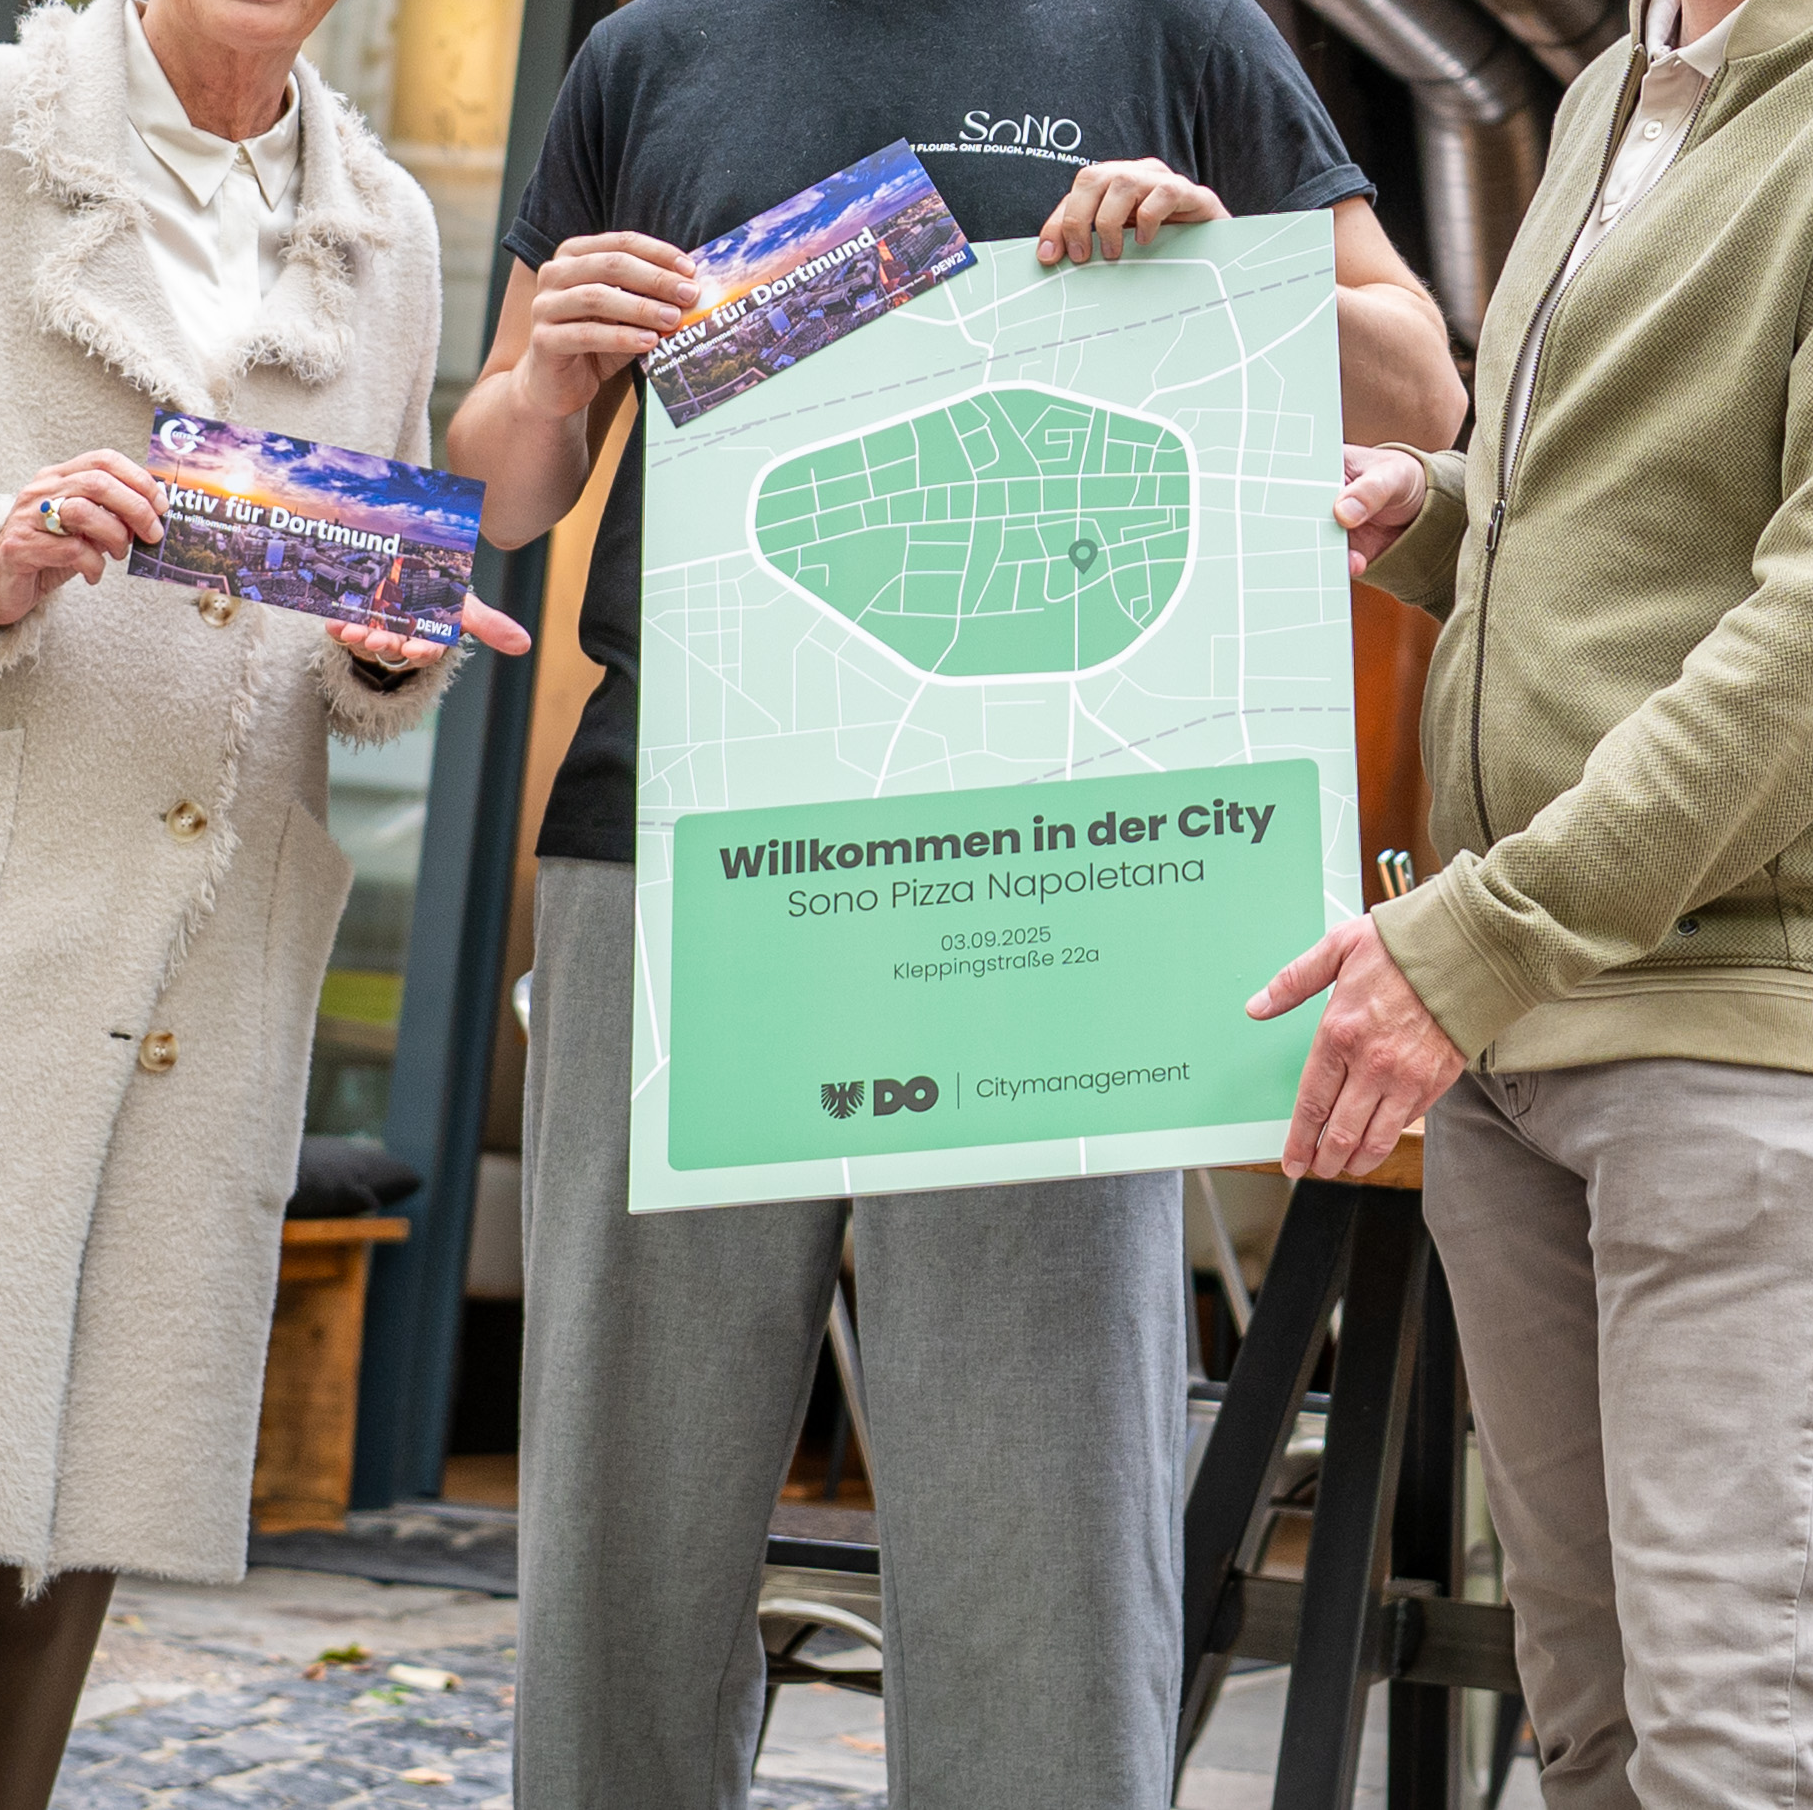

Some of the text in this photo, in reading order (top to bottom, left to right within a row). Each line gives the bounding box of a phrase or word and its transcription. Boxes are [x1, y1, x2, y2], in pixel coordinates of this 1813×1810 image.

[916, 143, 958, 152] FLOURS.
[959, 143, 982, 152] ONE
[983, 144, 1024, 155] DOUGH.
[1026, 147, 1056, 160] PIZZA
[647, 321, 707, 367] Aktiv
[711, 299, 746, 329] für
[749, 226, 877, 307] Dortmund
[653, 353, 688, 376] Herzlich
[225, 496, 264, 524] für
[269, 505, 401, 556] Dortmund
[719, 798, 1276, 880] Willkommen in der City
[787, 855, 1205, 918] Sono Pizza Napoletana
[893, 945, 1100, 983] Kleppingstraße 22a
[940, 925, 1052, 953] 03.09.2025
[872, 1061, 1191, 1117] DO Citymanagement
